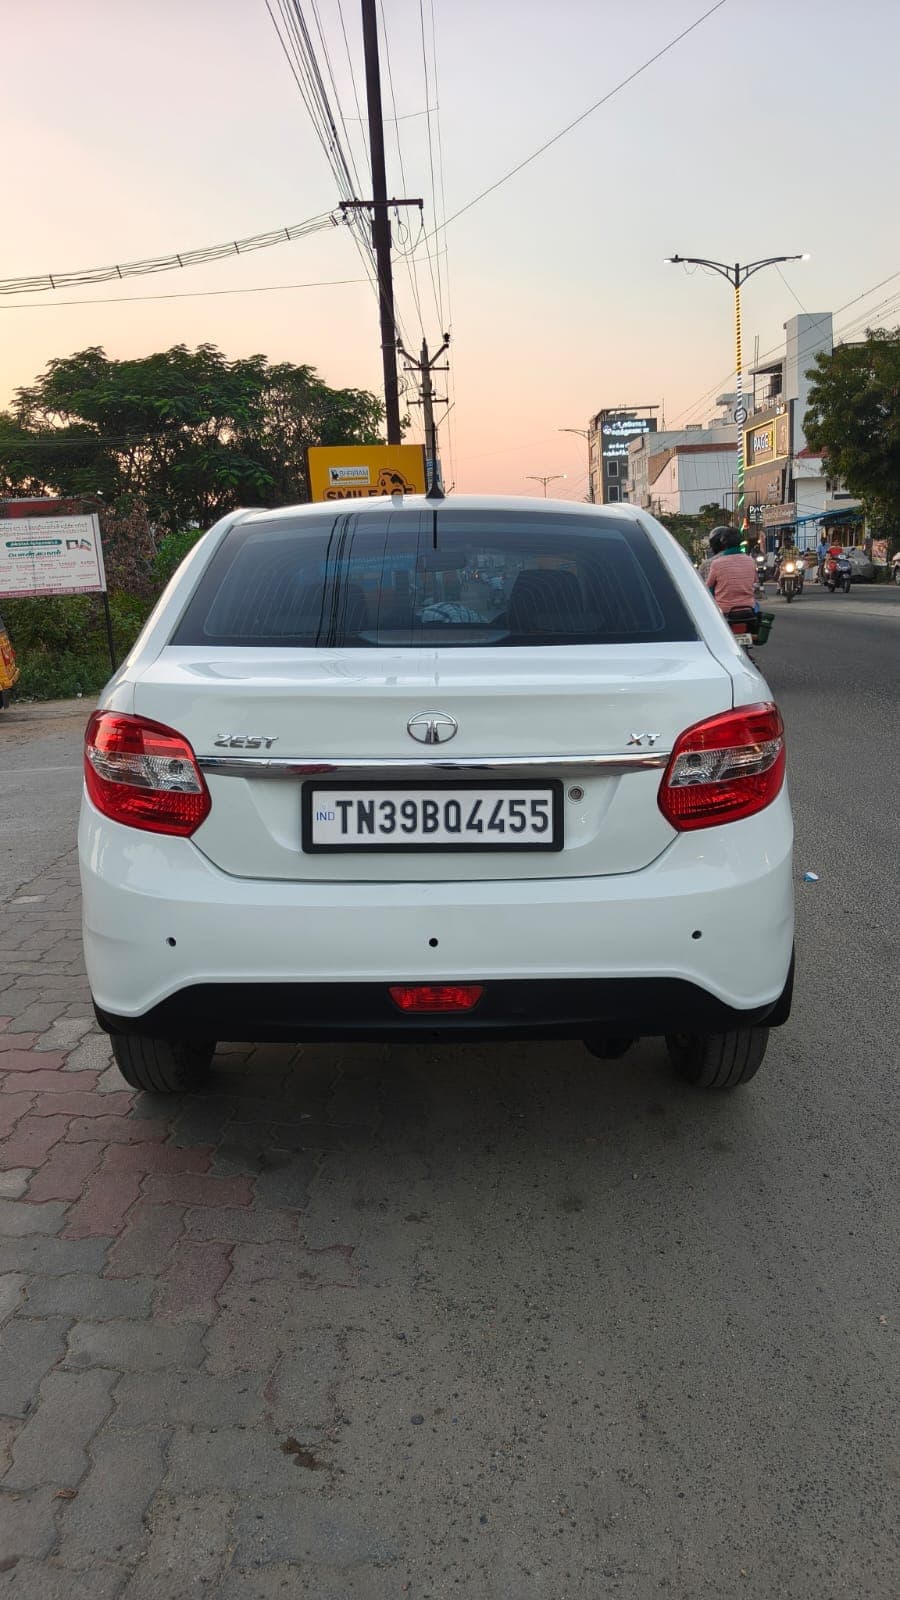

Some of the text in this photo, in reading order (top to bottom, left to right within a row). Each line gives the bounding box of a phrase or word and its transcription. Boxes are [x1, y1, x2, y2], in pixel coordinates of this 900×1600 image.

[214, 733, 279, 749] ZEST
[626, 733, 660, 746] XT
[316, 799, 549, 835] IND TN39BQ4455
